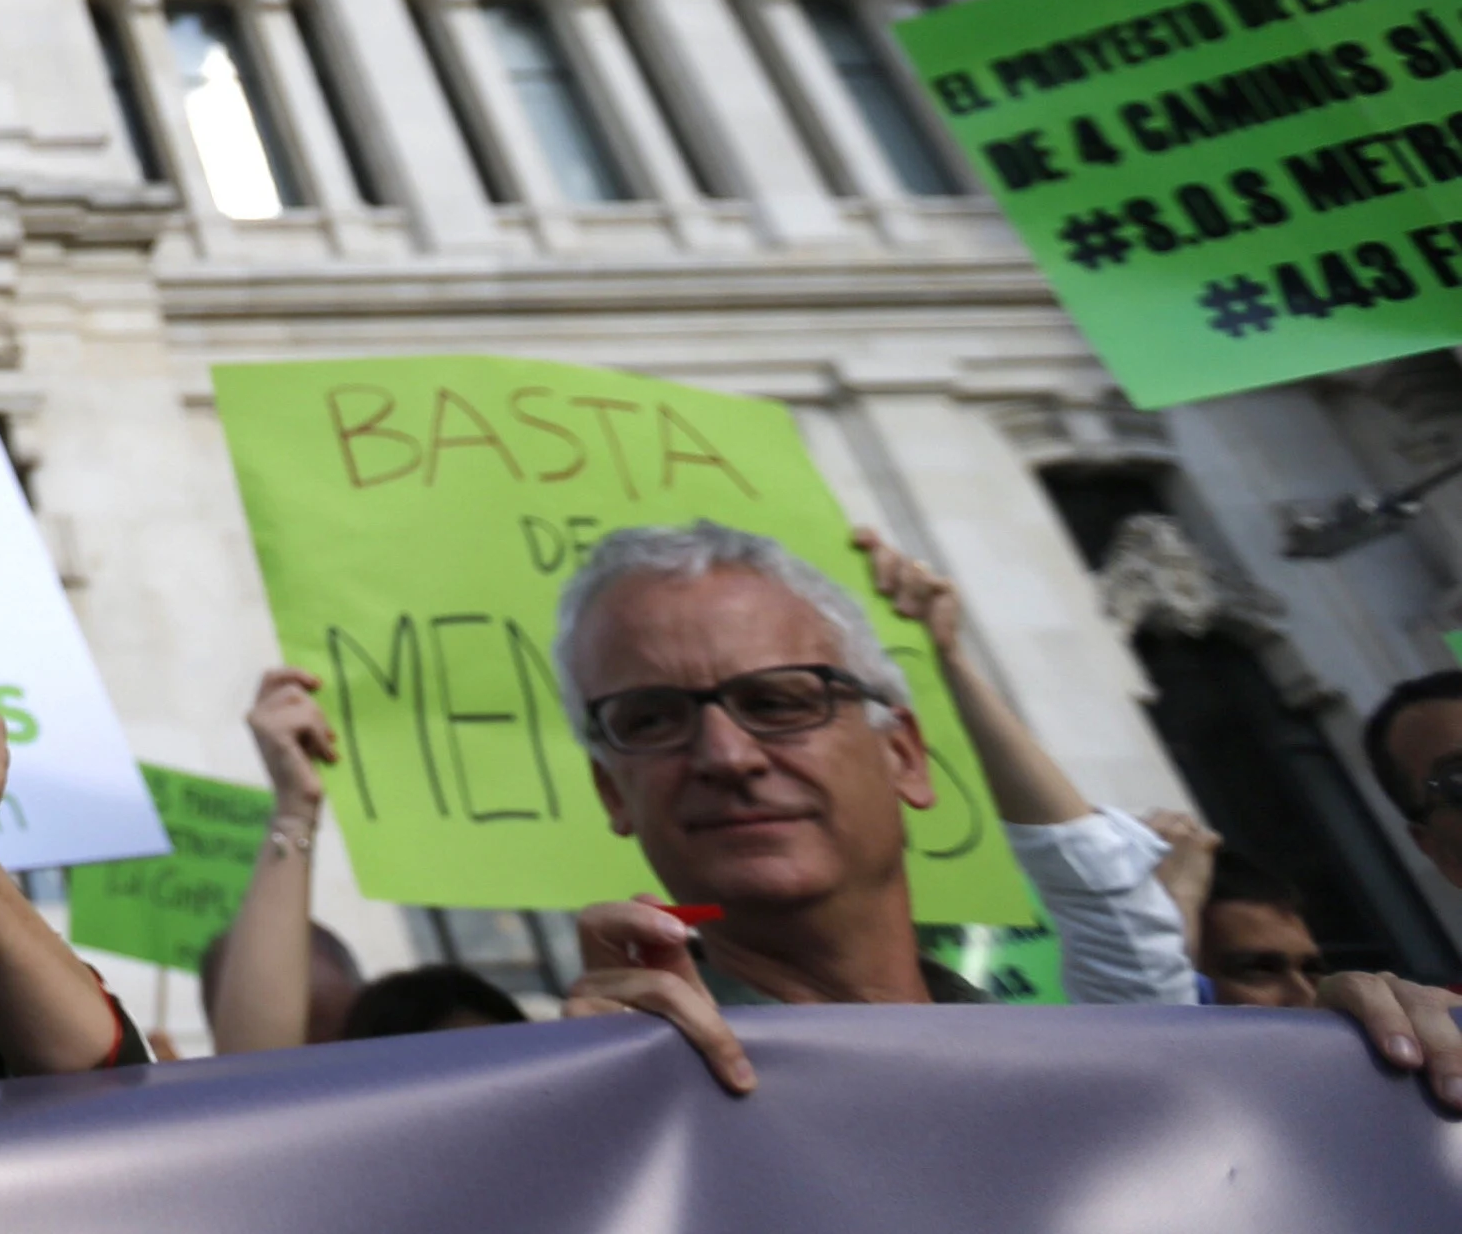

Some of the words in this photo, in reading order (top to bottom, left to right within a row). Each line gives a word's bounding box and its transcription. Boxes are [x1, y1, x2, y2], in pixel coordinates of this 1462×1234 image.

[982, 128, 1070, 193] DE
[1071, 114, 1124, 166] 4
[325, 383, 761, 503] BASTA
